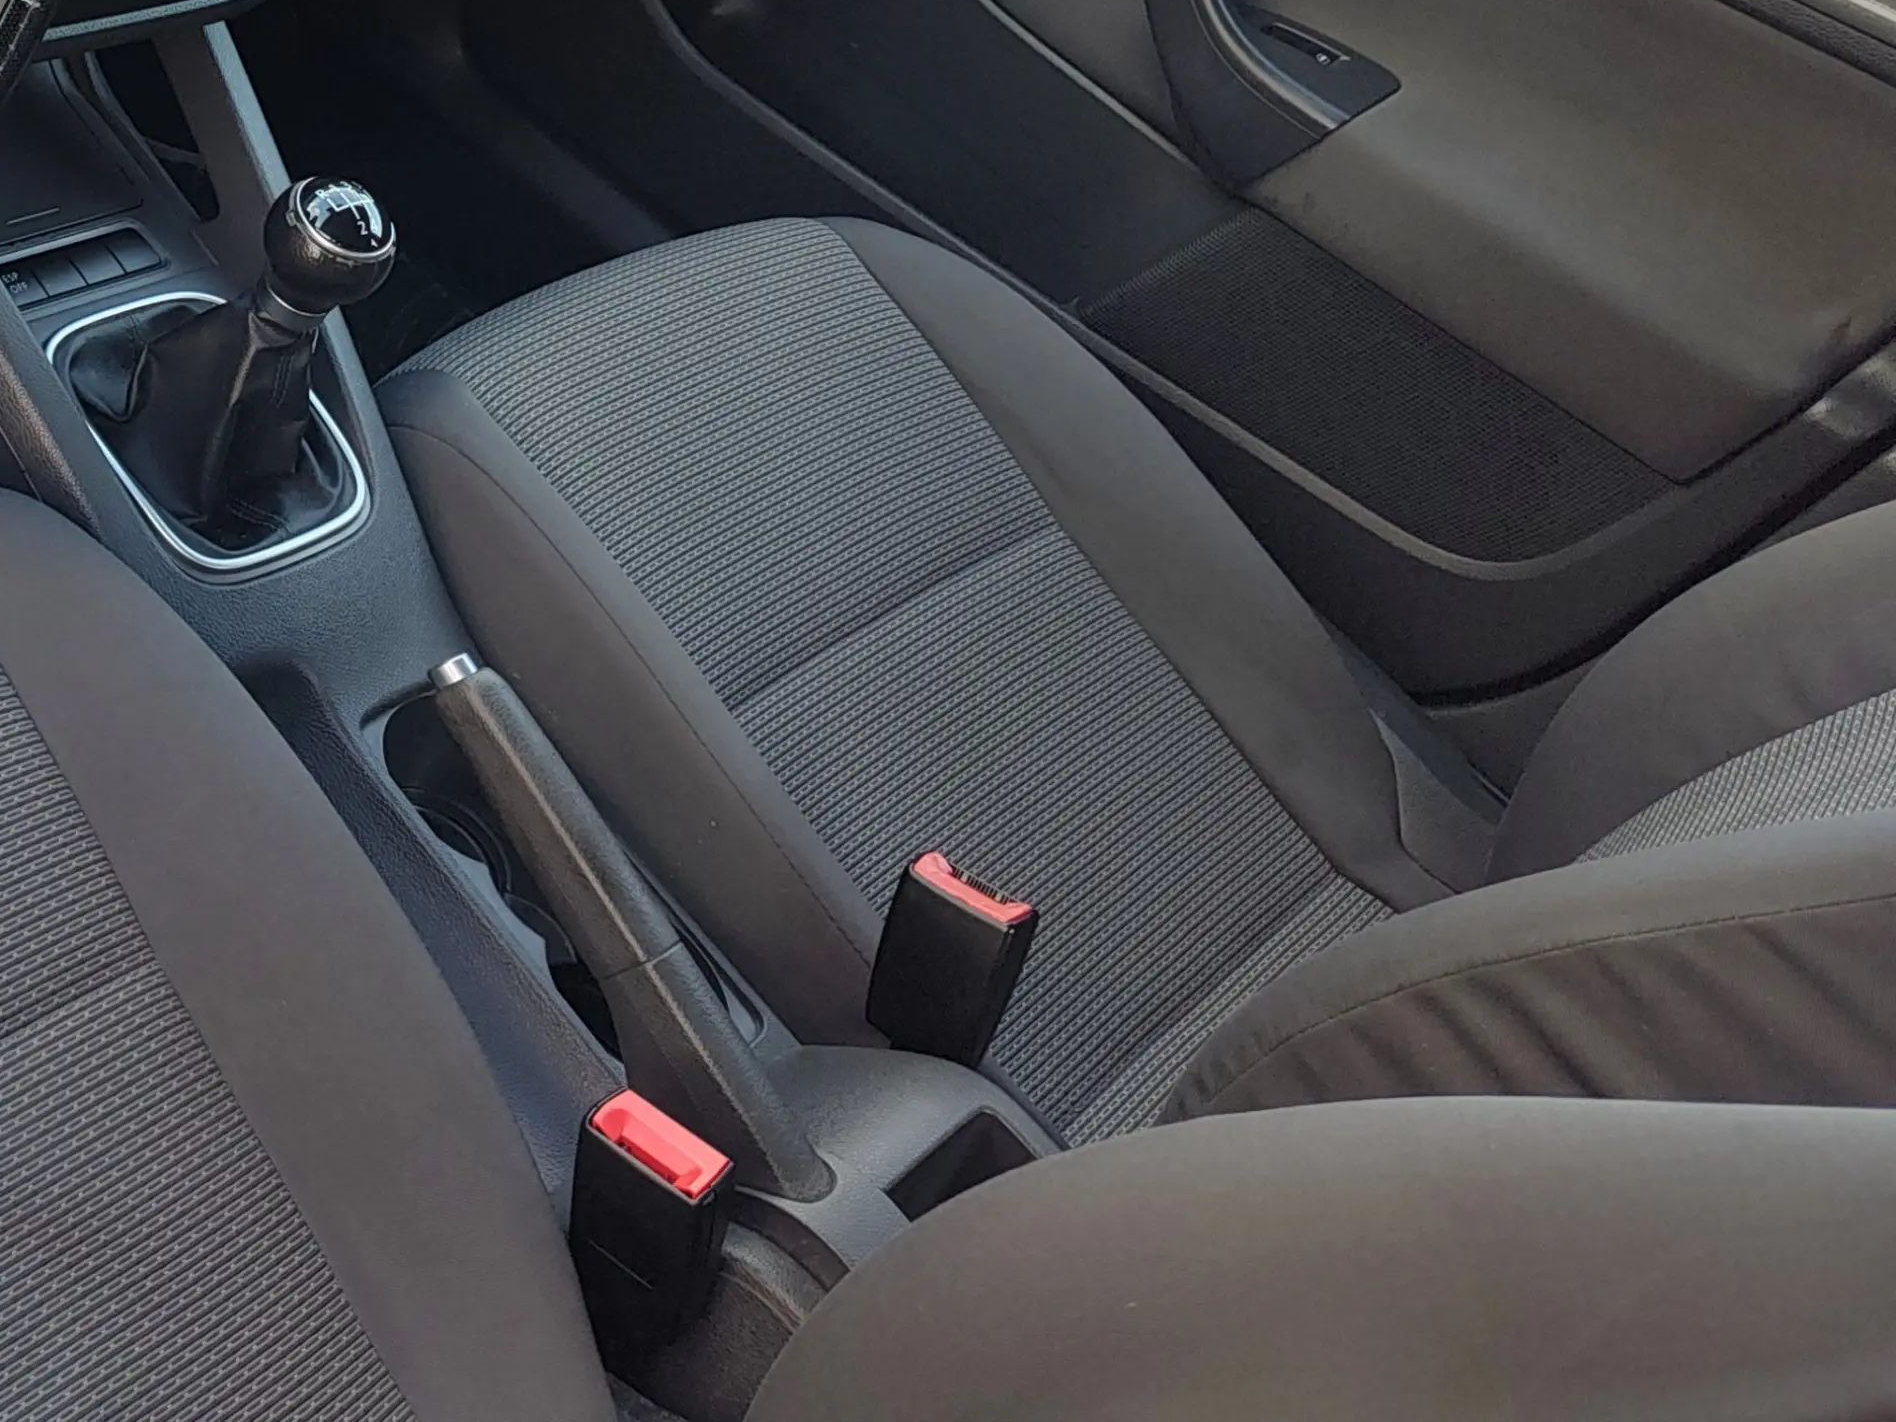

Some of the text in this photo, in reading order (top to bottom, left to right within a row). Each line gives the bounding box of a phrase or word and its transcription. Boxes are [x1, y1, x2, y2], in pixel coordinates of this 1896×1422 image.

[357, 221, 369, 236] 2
[2, 272, 19, 284] ESP
[10, 281, 29, 294] OFF
